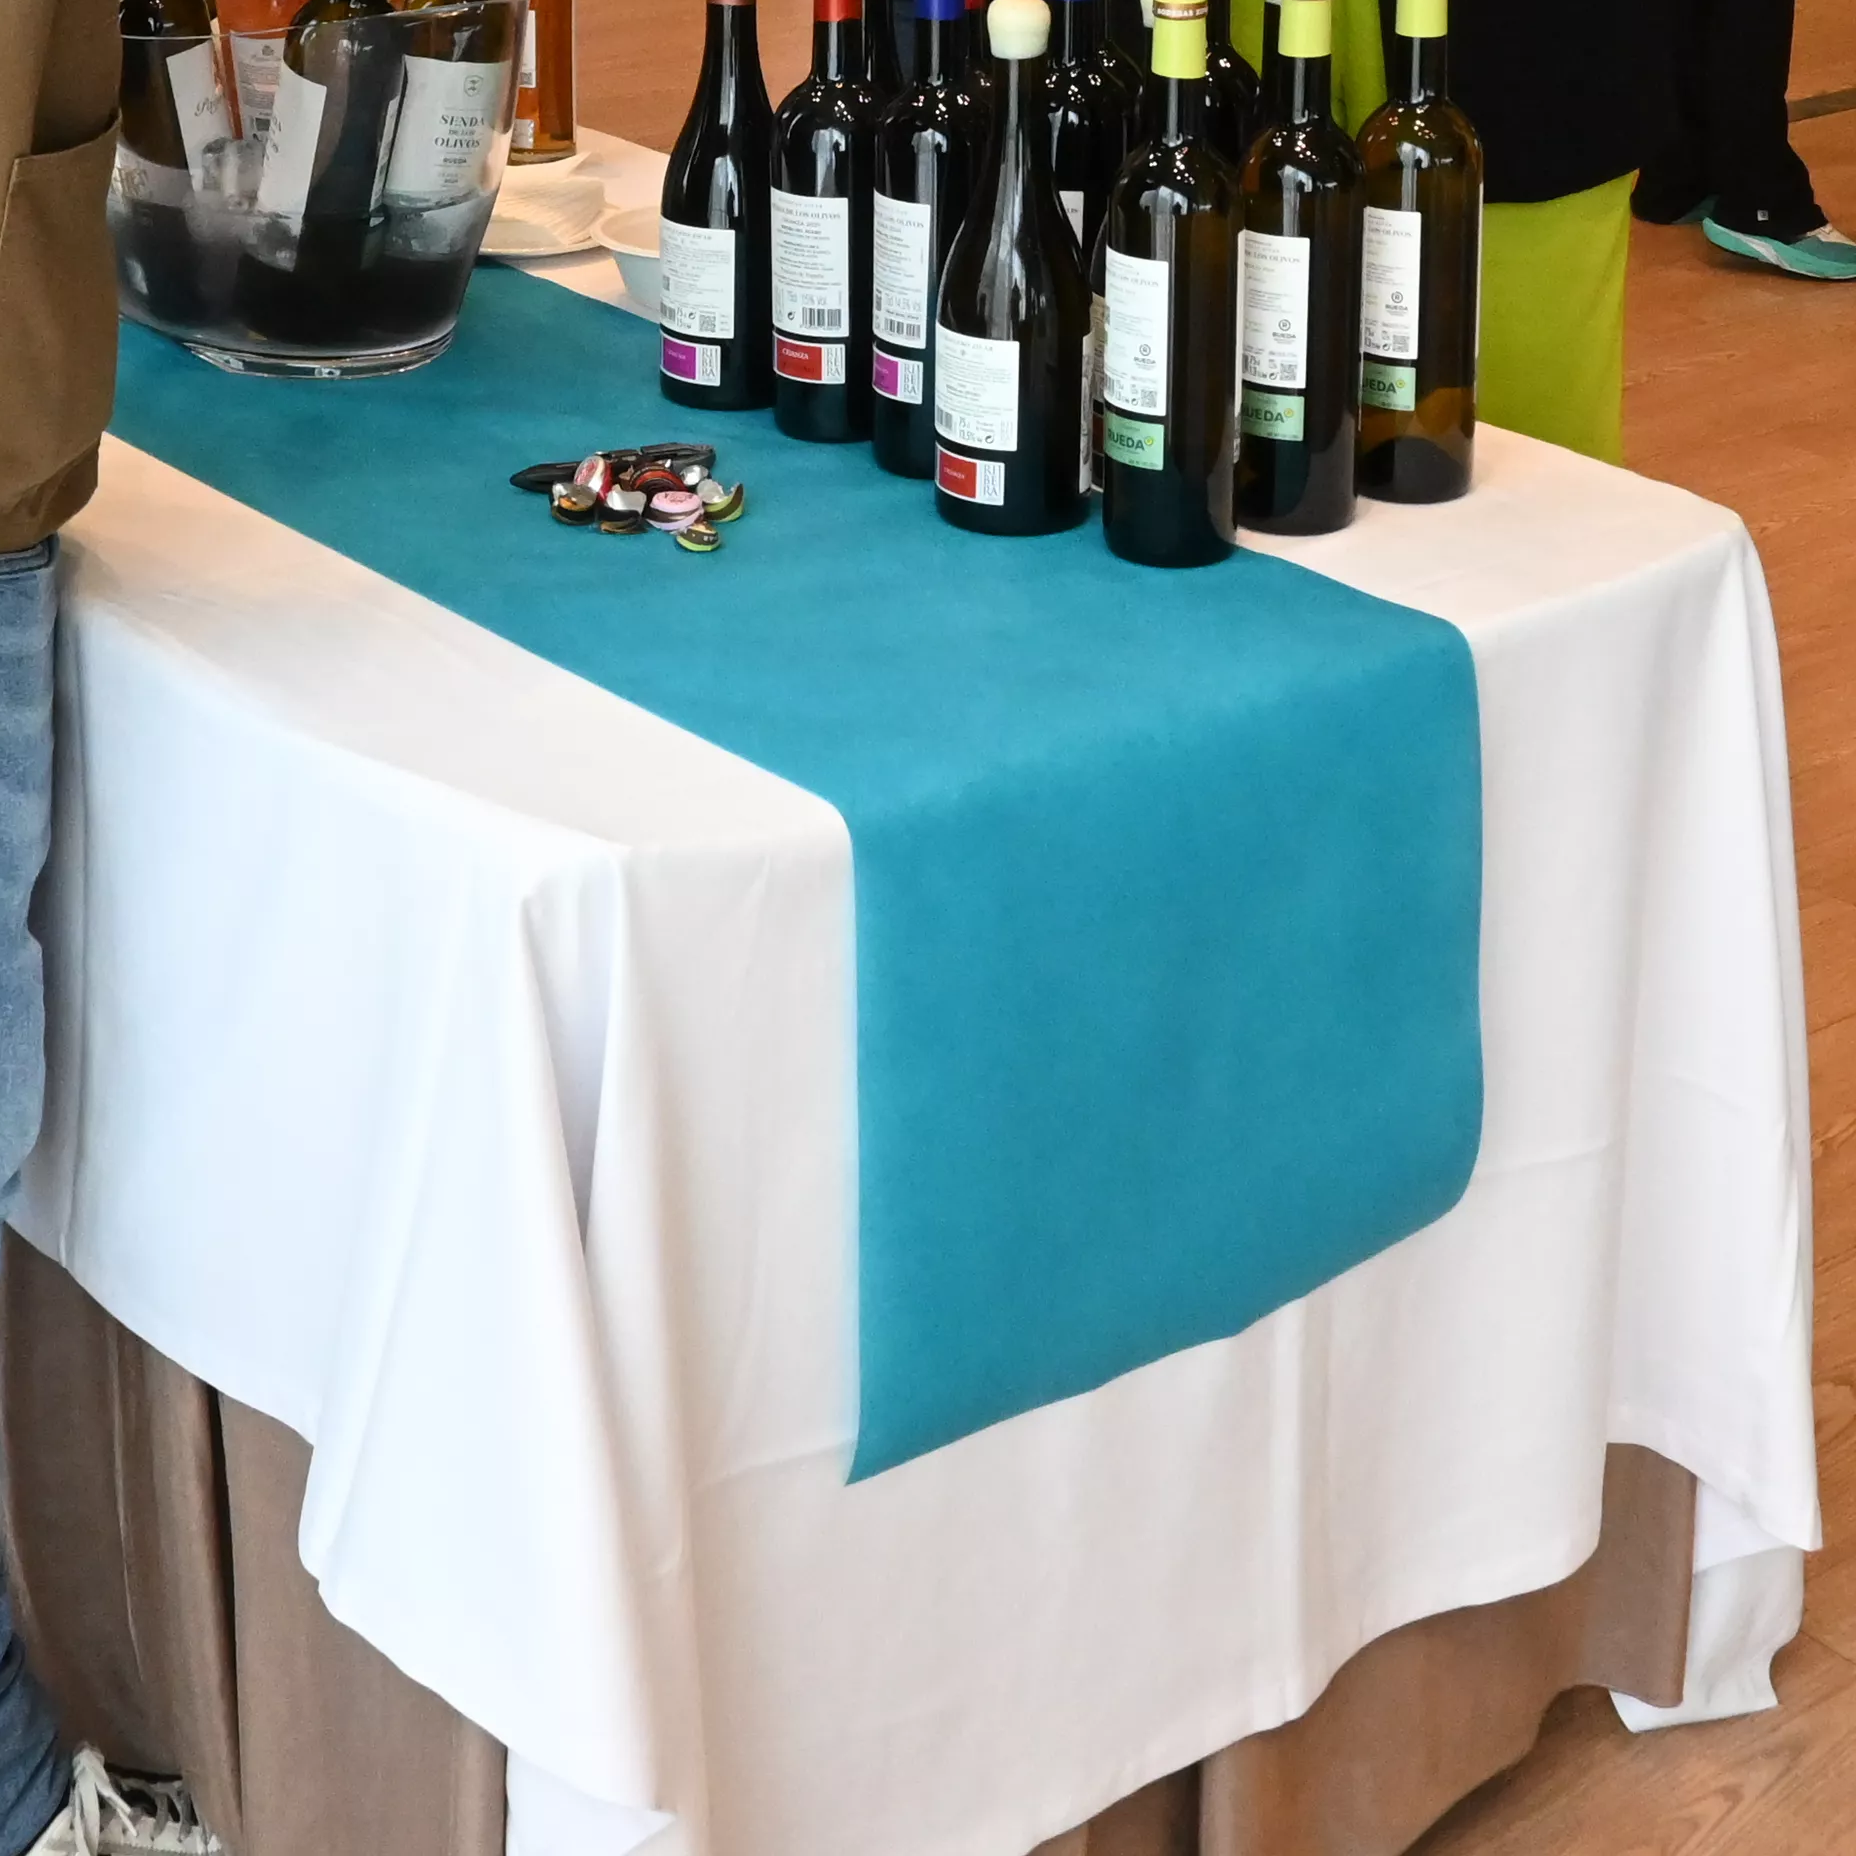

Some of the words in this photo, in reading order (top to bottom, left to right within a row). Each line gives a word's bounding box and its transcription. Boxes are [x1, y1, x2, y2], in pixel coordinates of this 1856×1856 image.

[439, 114, 485, 128] SENDA
[434, 137, 481, 149] OLIVOS
[1362, 377, 1397, 394] UEDA
[1107, 427, 1146, 451] RUEDA
